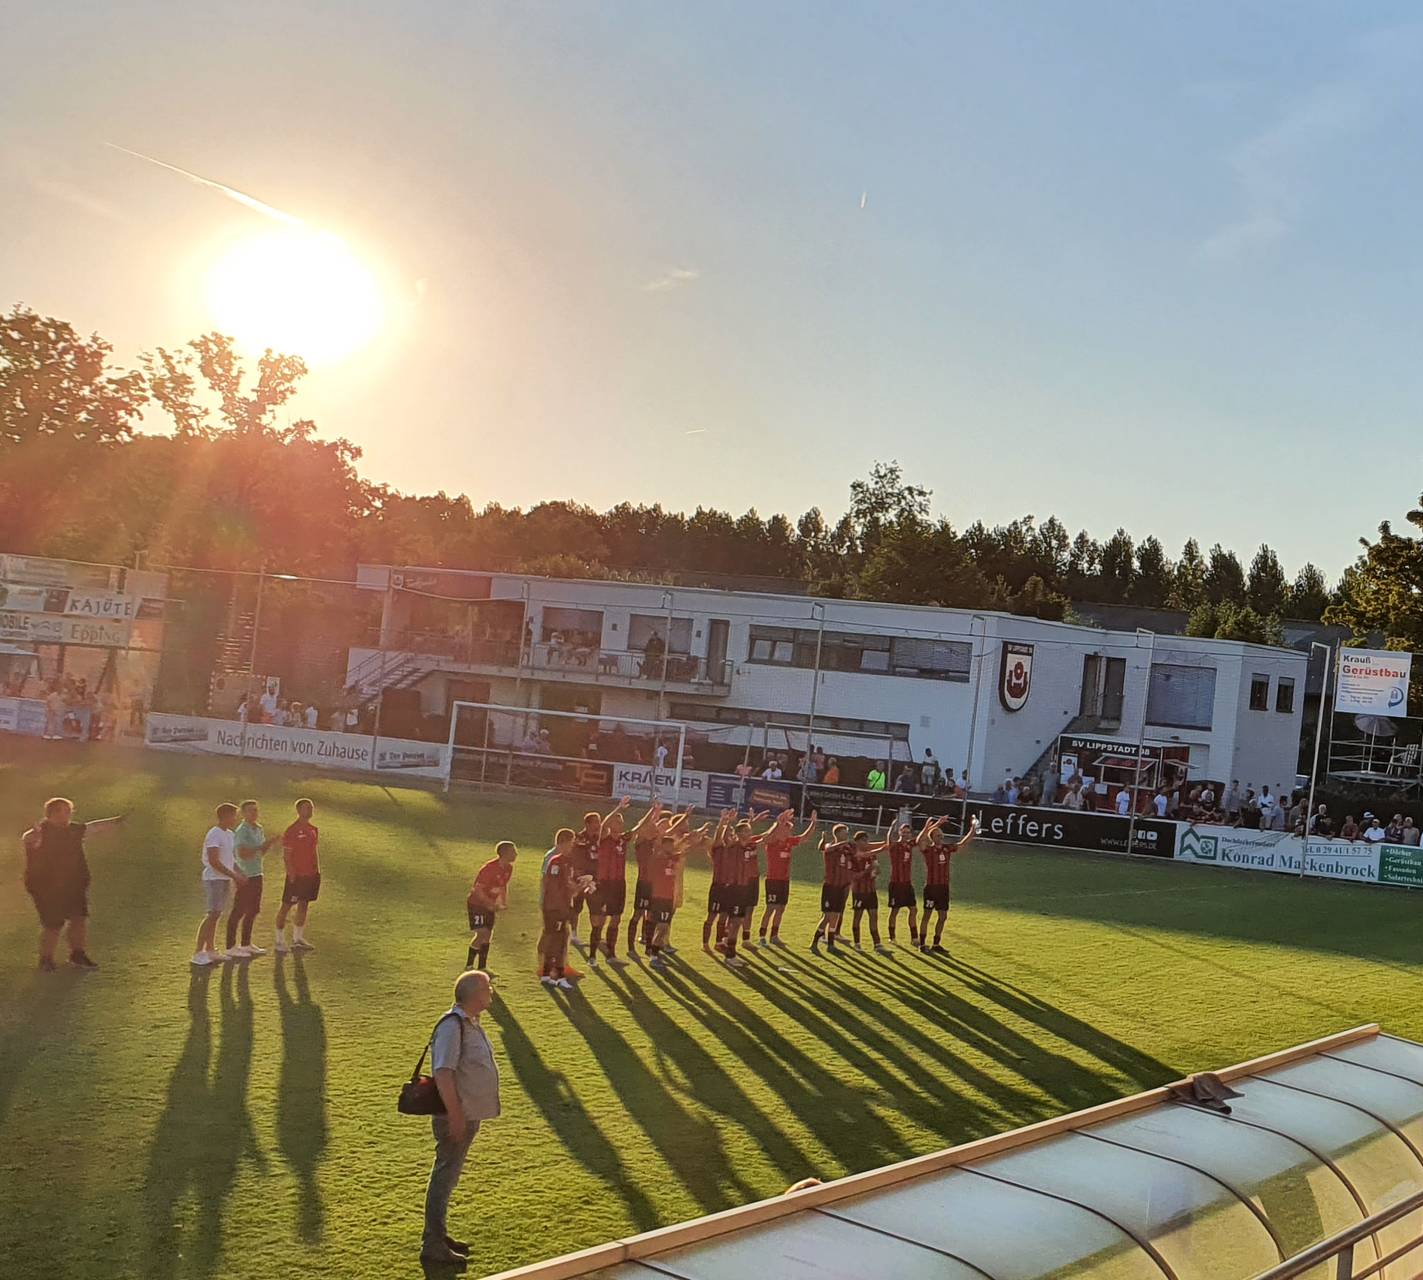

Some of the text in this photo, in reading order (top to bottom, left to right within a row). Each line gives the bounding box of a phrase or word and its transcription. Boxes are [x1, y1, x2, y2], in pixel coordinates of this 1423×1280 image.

[69, 598, 133, 616] KAJÜTE
[0, 612, 30, 630] OBILE
[1343, 654, 1371, 664] Krauß
[1342, 664, 1407, 679] Gerüstbau
[292, 740, 313, 756] von
[316, 740, 369, 761] Zuhause
[1072, 740, 1085, 748] SV
[1086, 741, 1137, 754] LIPPSTADT
[976, 809, 1064, 840] Leffers
[1221, 848, 1275, 867] Konrad
[473, 914, 484, 925] 21
[660, 911, 670, 921] 17
